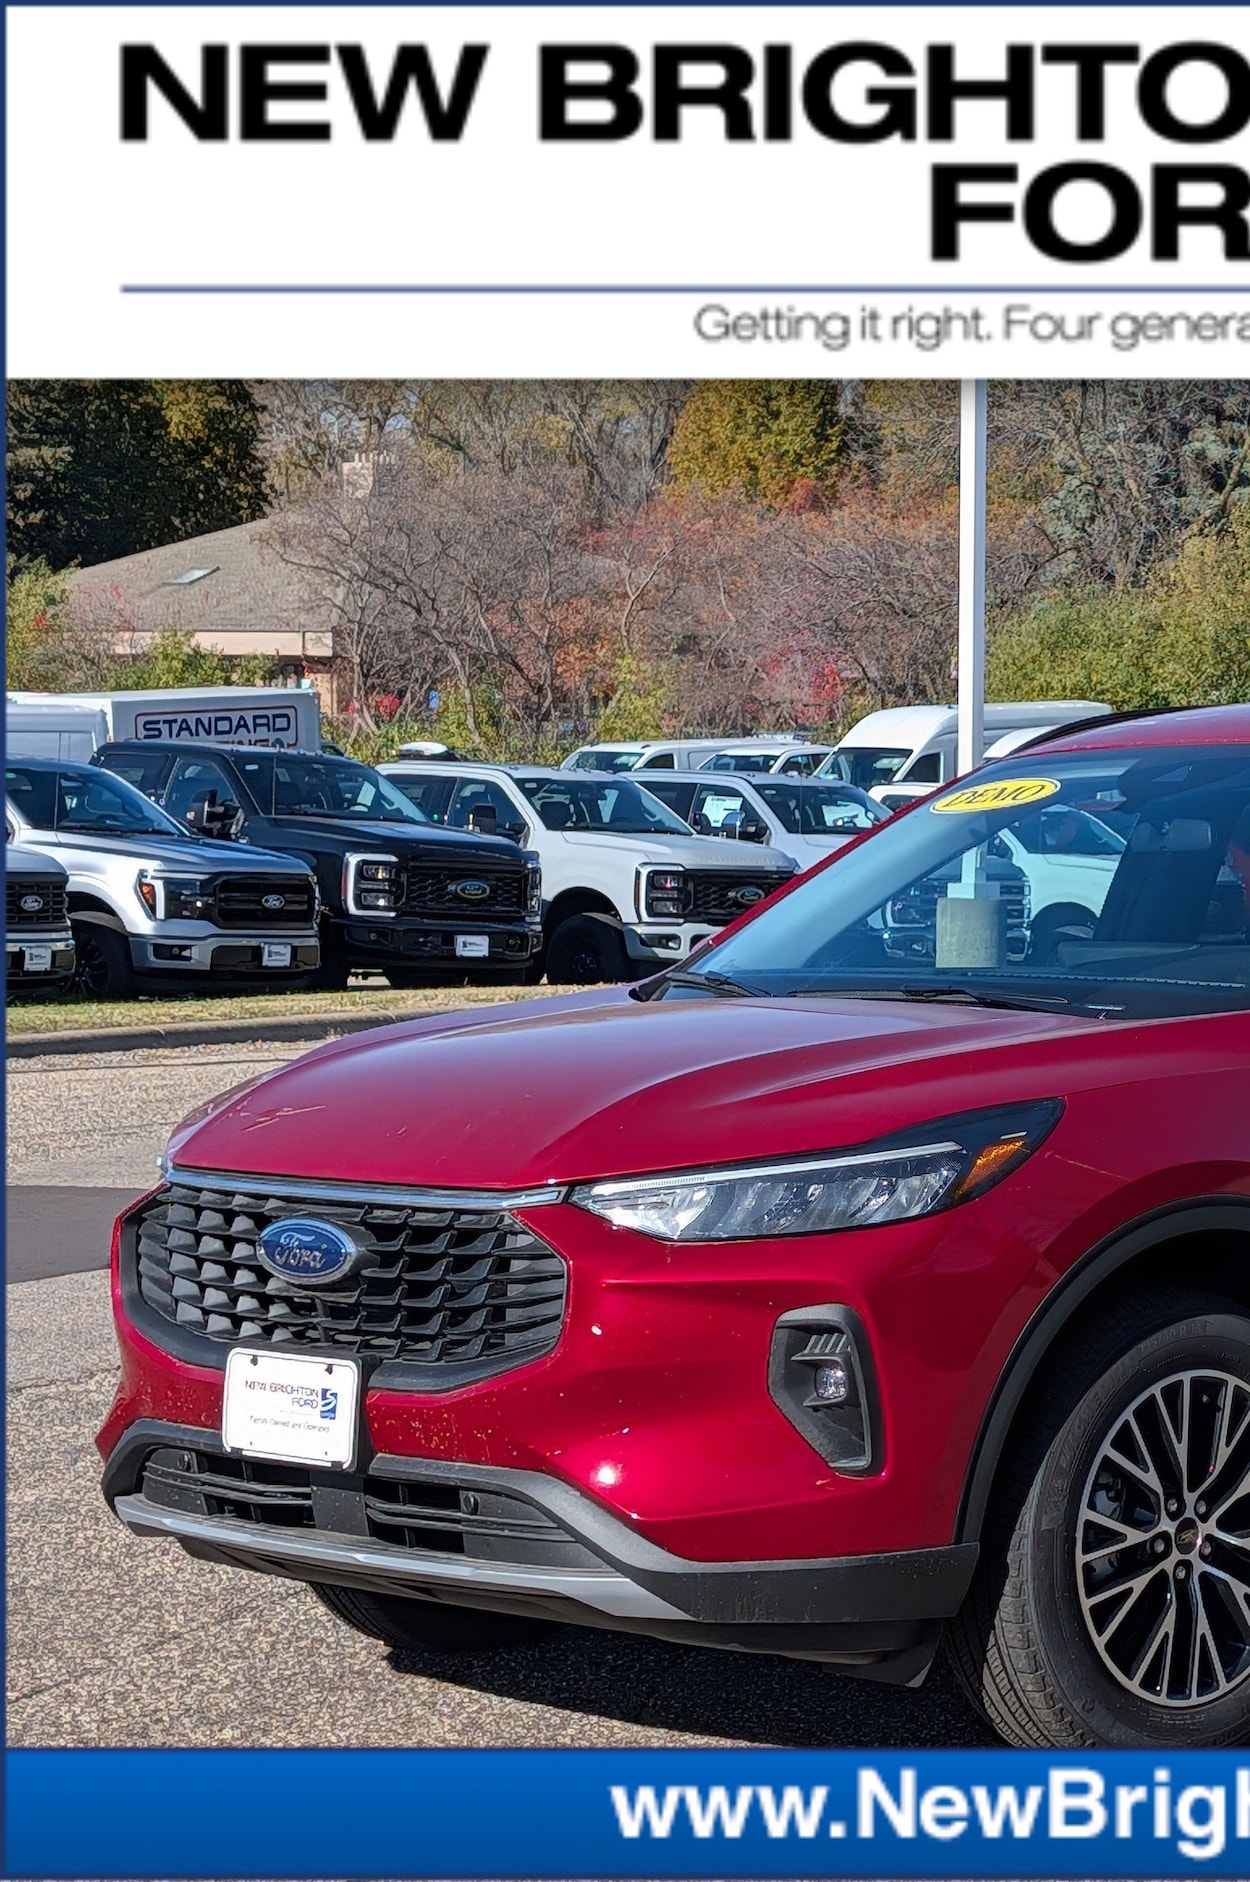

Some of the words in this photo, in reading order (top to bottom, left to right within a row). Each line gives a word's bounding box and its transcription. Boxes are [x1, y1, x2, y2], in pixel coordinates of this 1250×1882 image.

[143, 713, 291, 740] STANDARD
[943, 784, 1046, 808] DEMO
[274, 1231, 327, 1269] Ford
